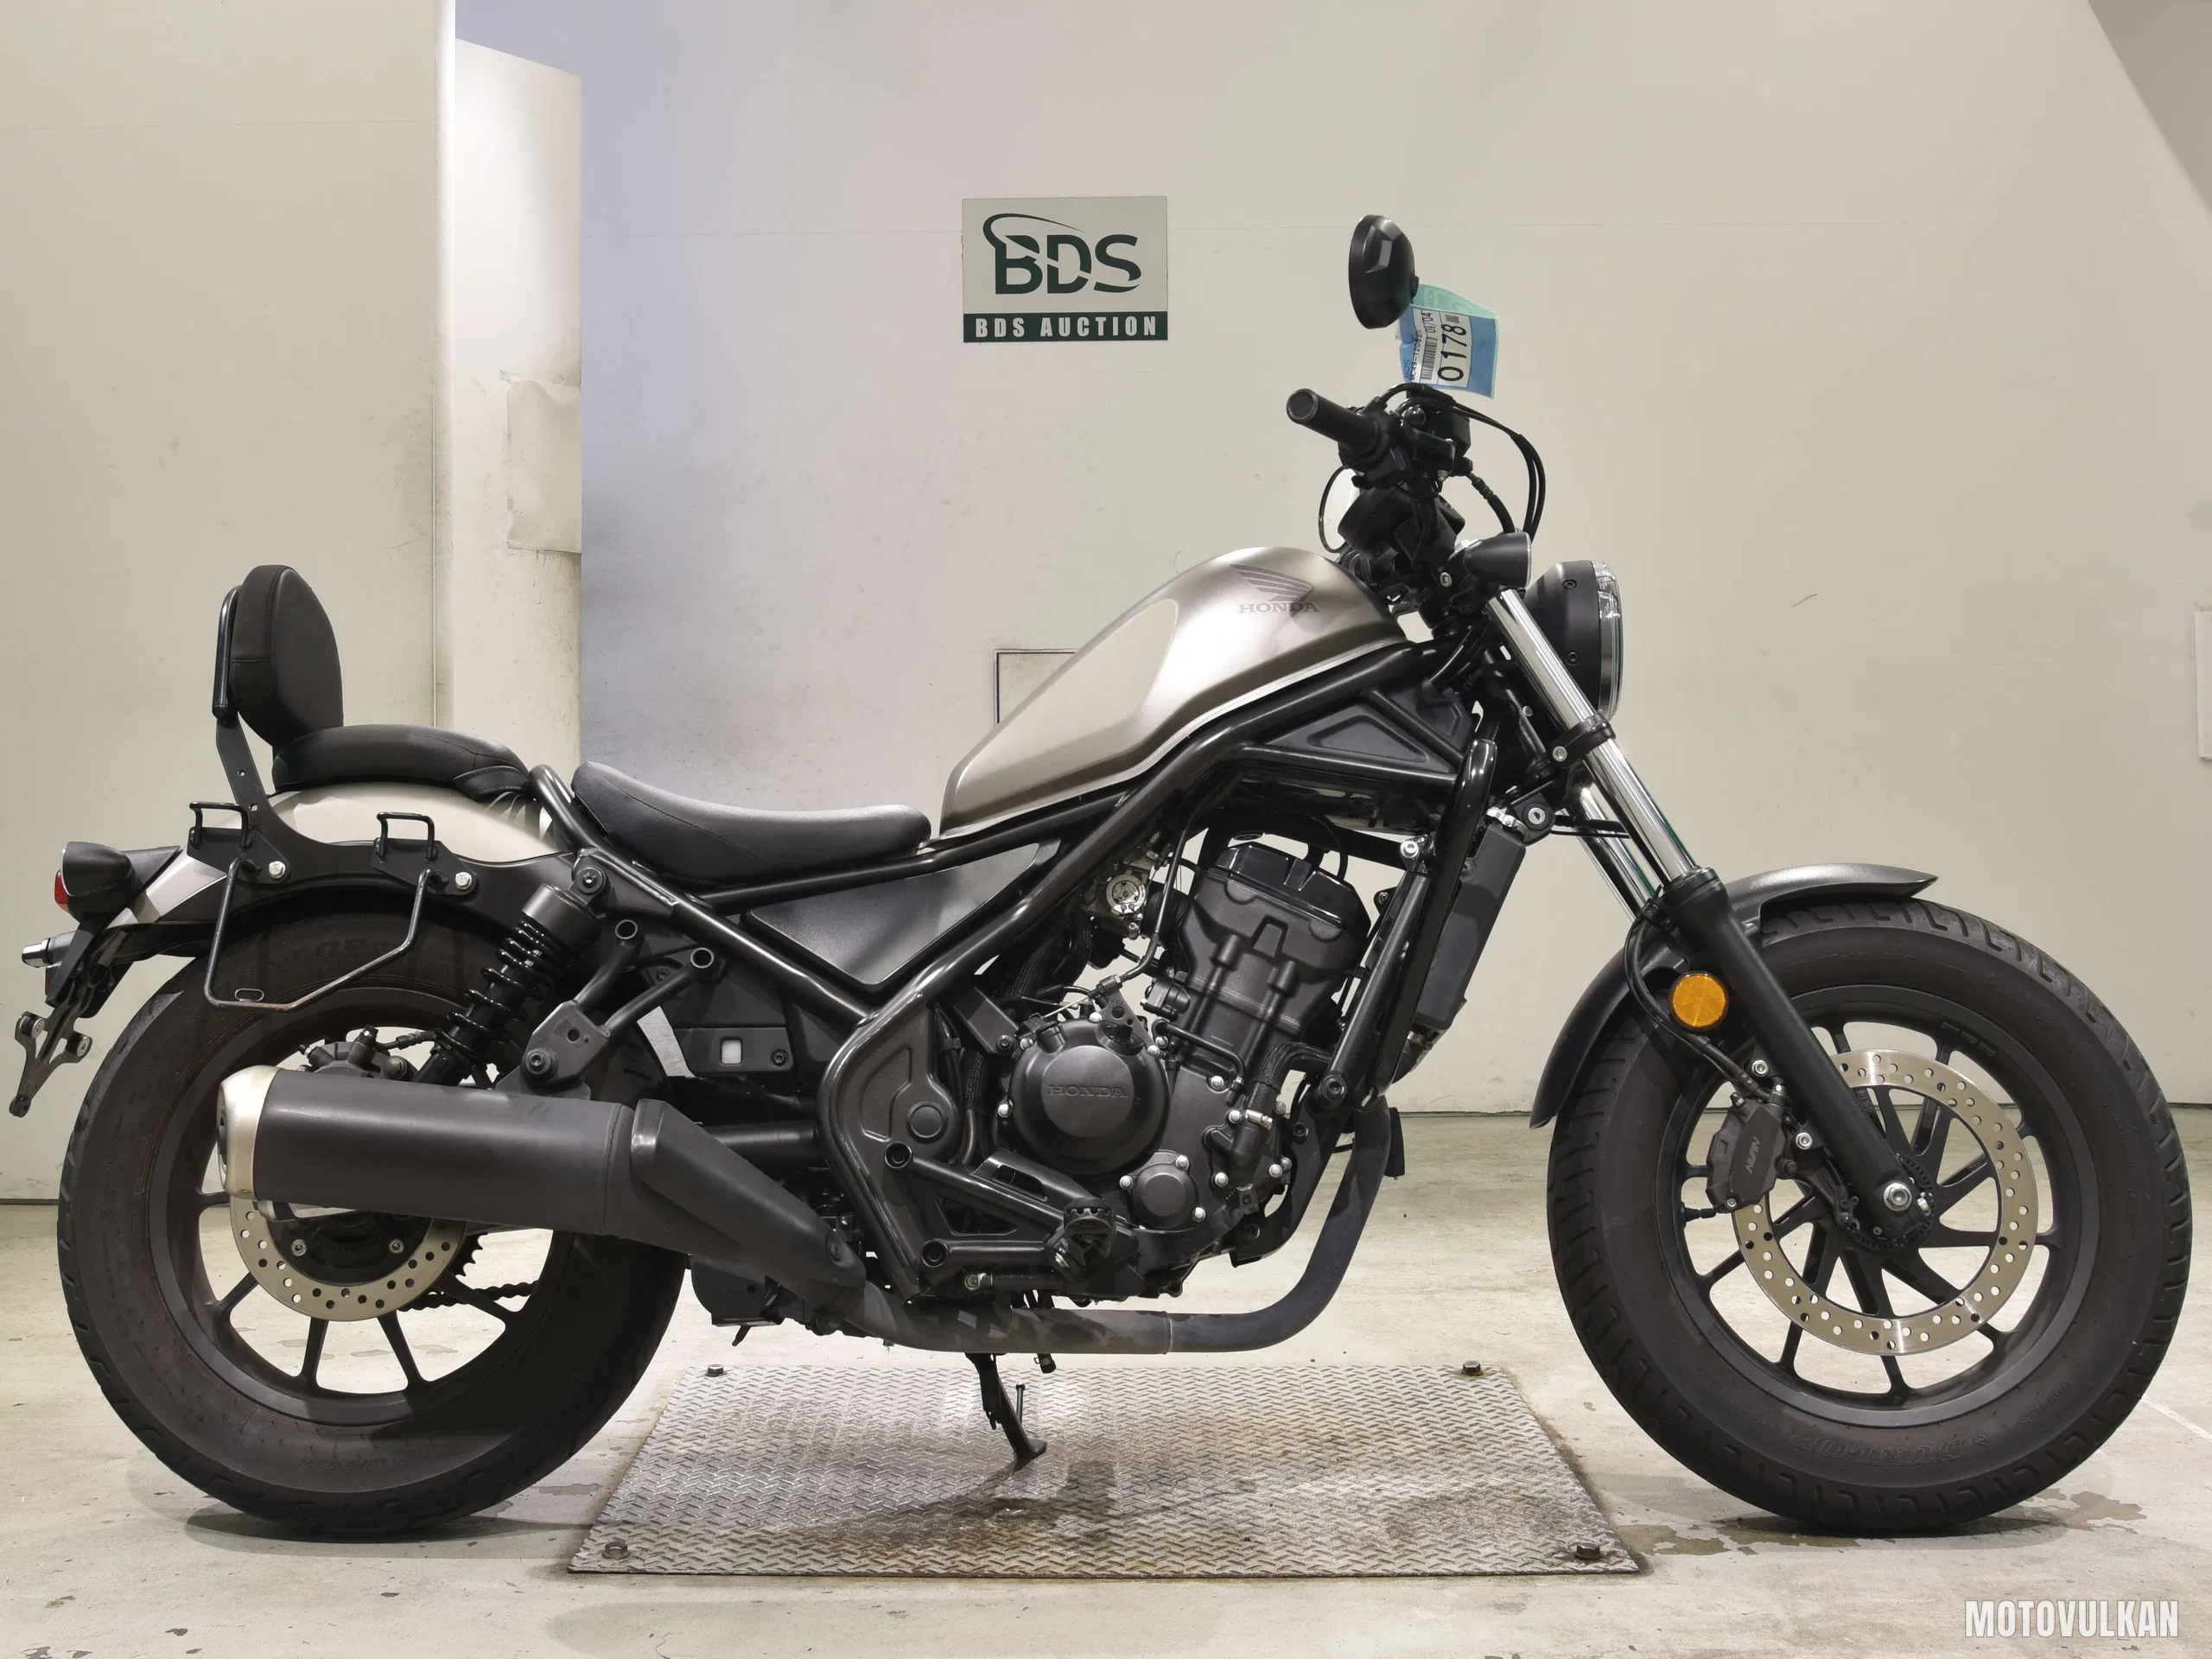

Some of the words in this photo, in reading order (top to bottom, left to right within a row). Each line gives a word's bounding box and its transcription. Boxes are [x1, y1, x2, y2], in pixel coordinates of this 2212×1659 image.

[992, 232, 1141, 295] BDS
[976, 317, 1025, 338] BDS
[1039, 315, 1156, 337] AUCTION
[1437, 323, 1467, 382] 0178
[1237, 602, 1320, 613] HONDA
[1047, 1084, 1128, 1098] HONDA
[1788, 1434, 1967, 1466] DUNLOP
